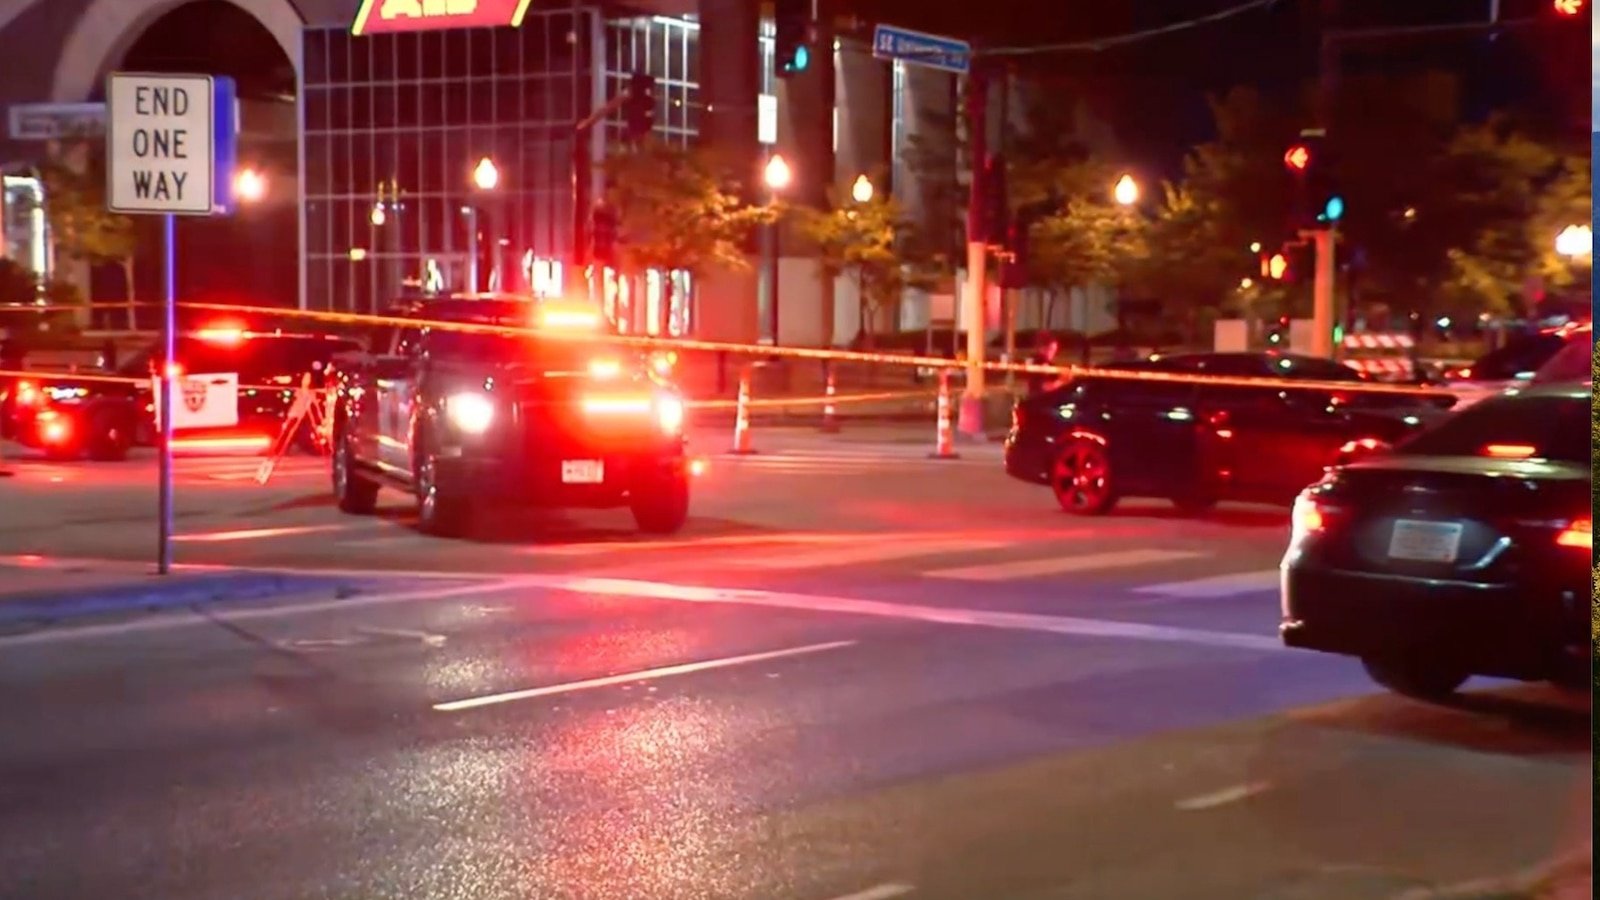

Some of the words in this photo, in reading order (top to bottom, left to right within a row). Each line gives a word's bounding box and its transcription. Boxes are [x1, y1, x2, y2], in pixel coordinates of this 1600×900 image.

[135, 86, 188, 116] END
[133, 128, 187, 159] ONE
[132, 170, 188, 201] WAY
